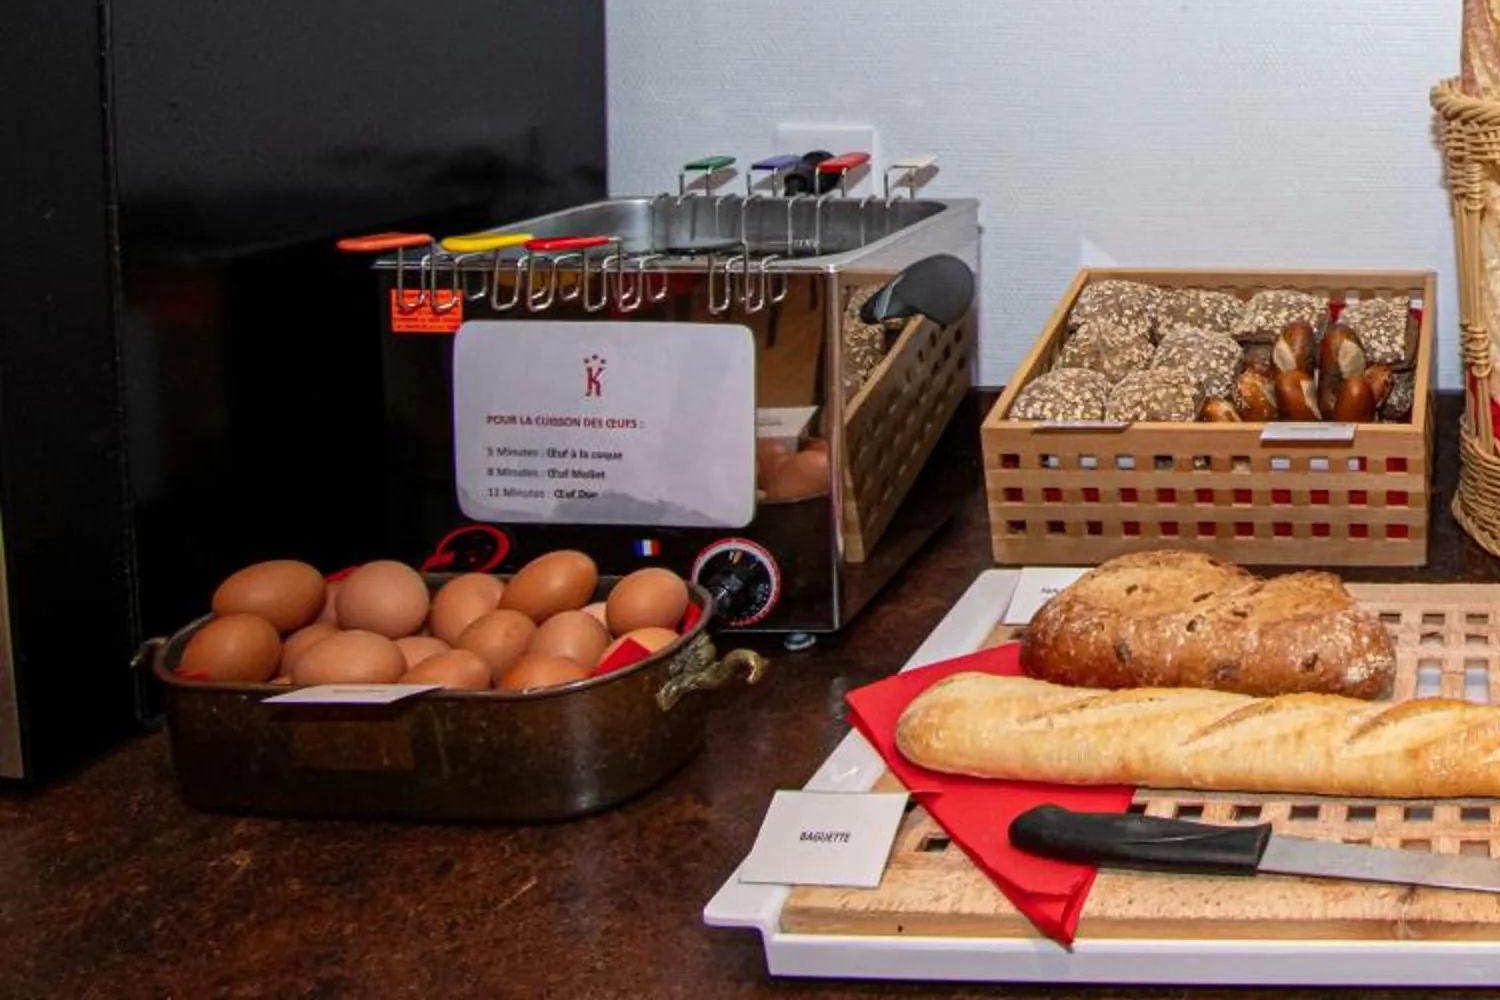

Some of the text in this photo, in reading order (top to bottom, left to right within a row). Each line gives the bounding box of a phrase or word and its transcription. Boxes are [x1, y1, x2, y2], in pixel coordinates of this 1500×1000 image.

[487, 415, 517, 426] POUR
[519, 415, 532, 426] LA
[534, 415, 581, 428] CUISSON
[583, 417, 602, 428] DES
[605, 418, 637, 429] ŒUFS
[497, 447, 539, 457] Minutes
[579, 448, 589, 459] la
[591, 451, 623, 461] coque
[497, 467, 539, 477] Minutes
[503, 487, 545, 498] Minutes
[800, 831, 851, 843] BAGUETTE
